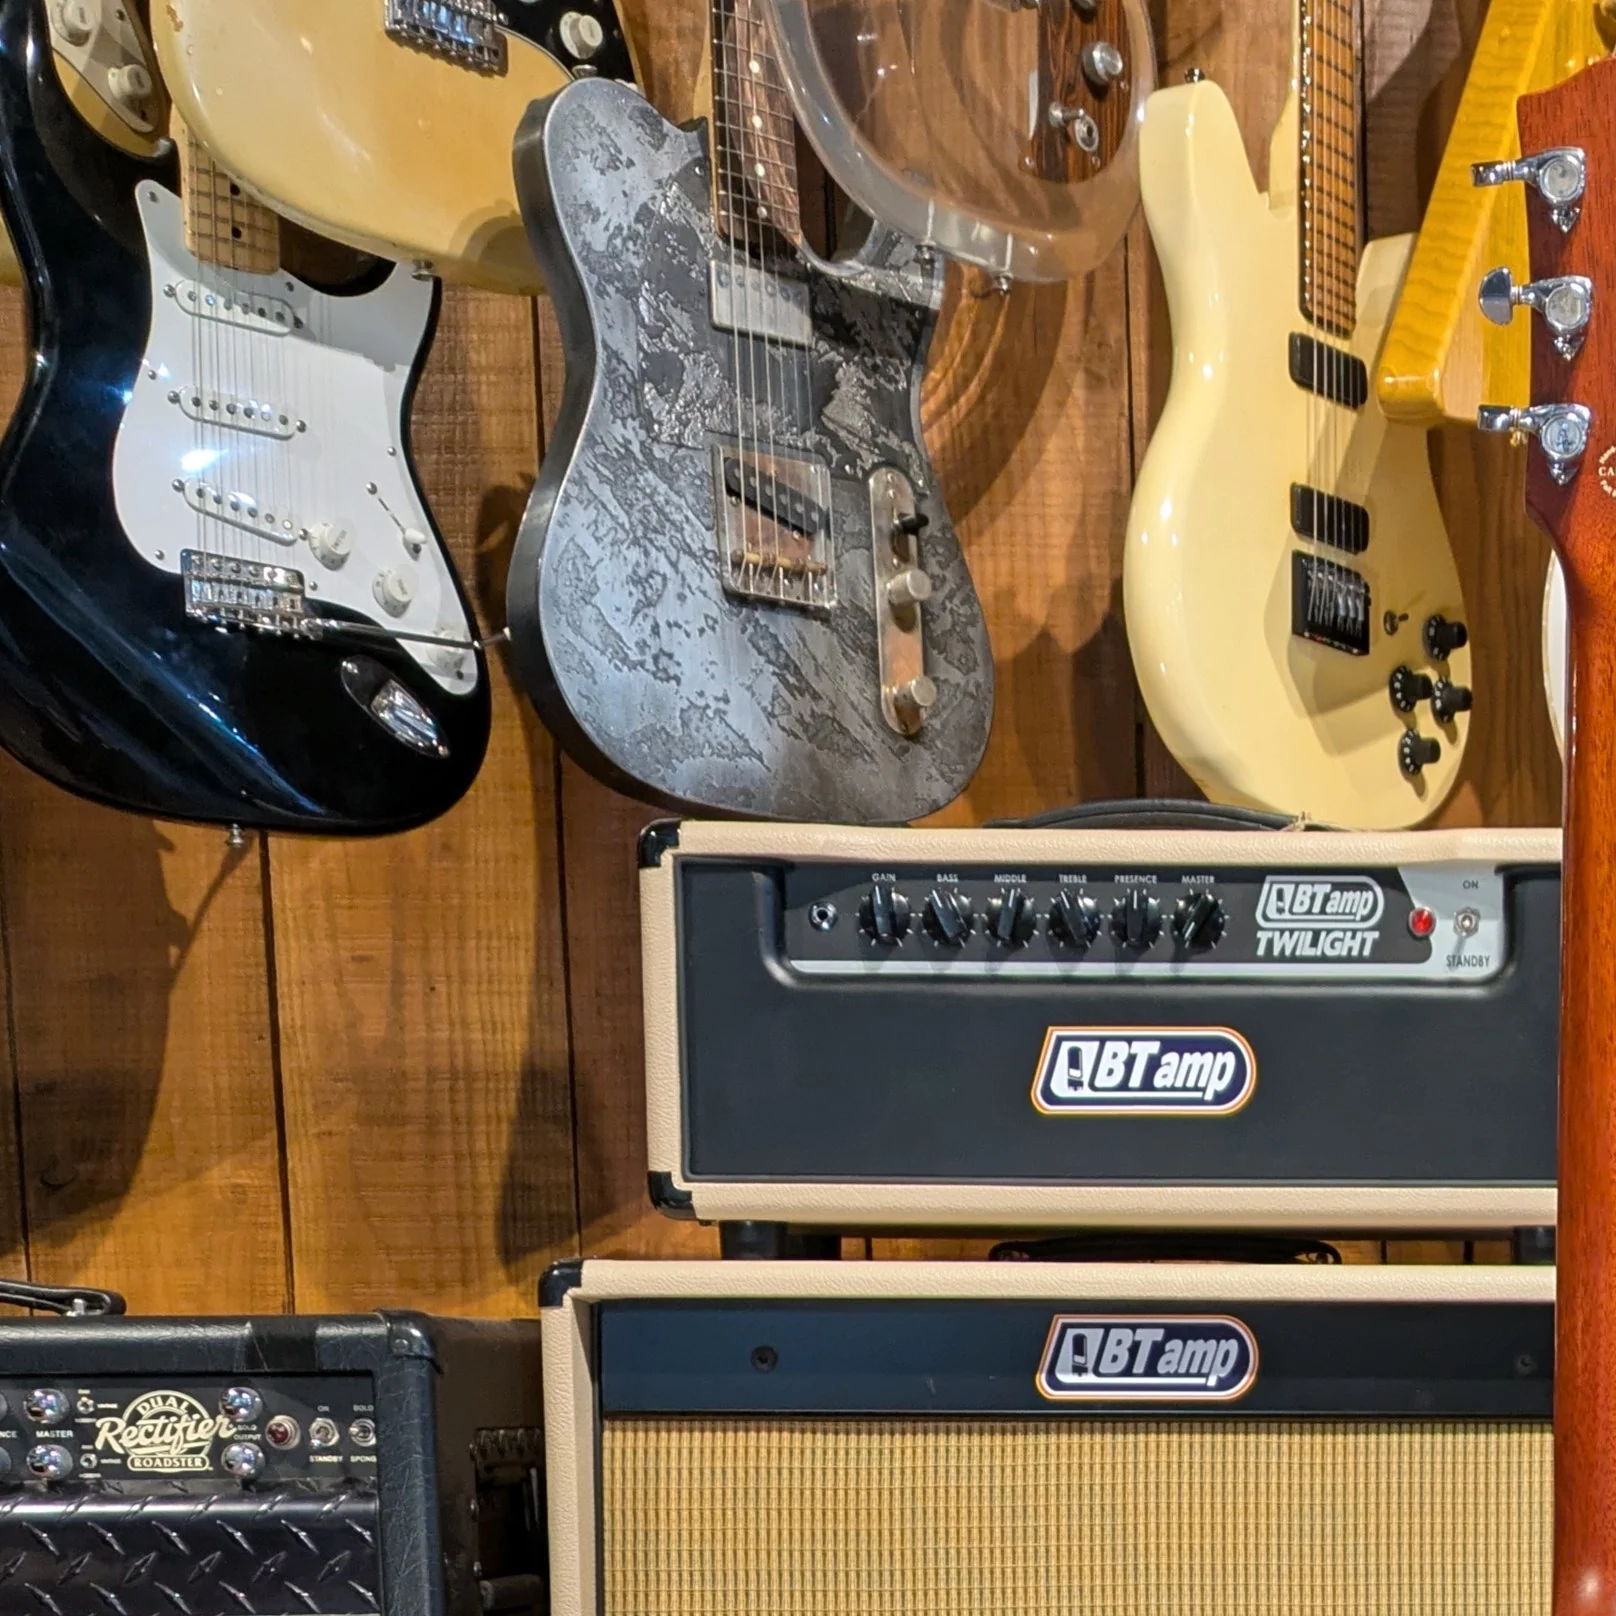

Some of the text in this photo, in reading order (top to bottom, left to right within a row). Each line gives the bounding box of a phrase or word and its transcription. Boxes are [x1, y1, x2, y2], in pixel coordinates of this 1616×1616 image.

[872, 873, 896, 882] GAIN
[936, 873, 959, 882] BASS
[994, 874, 1027, 883] MIDDLE
[1058, 874, 1087, 884] TREBLE
[1114, 875, 1157, 884] PRESENCE
[1181, 875, 1215, 884] MASTER
[1462, 880, 1479, 889] ON
[1256, 930, 1380, 957] TWILIGHT
[1446, 956, 1490, 968] STANDBY
[136, 1396, 189, 1416] DUAL
[35, 1430, 74, 1438] MASTER
[95, 1414, 237, 1457] Rectifier
[233, 1433, 262, 1441] OUTPUT
[134, 1457, 203, 1468] ROADSTER
[309, 1455, 343, 1463] STANDBY
